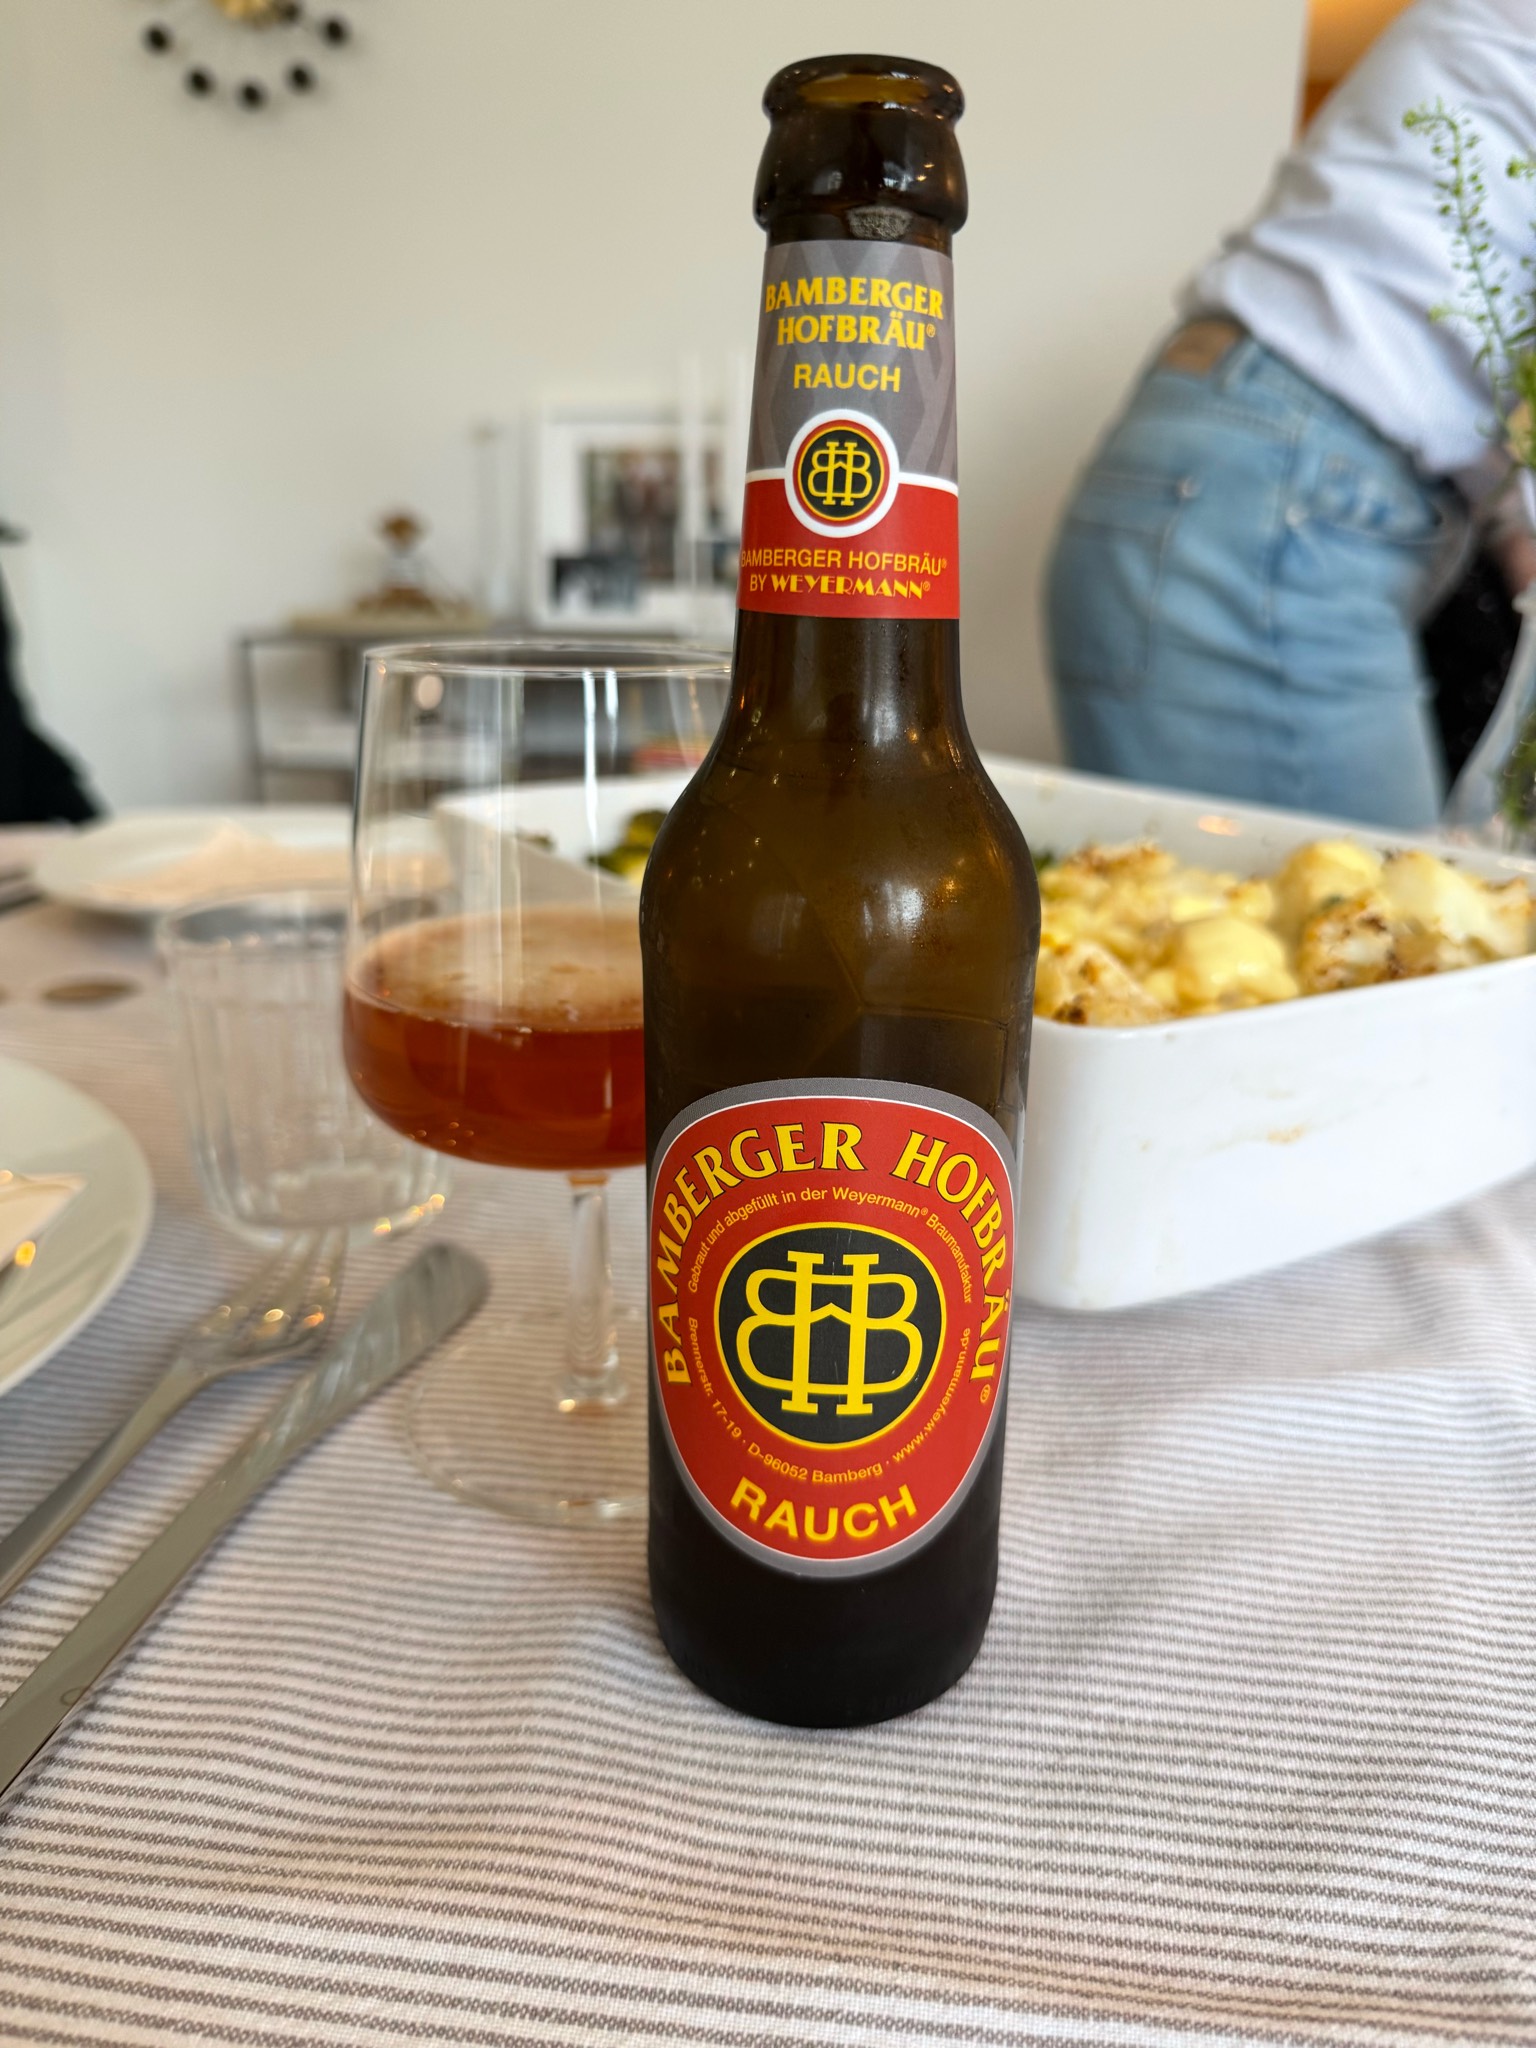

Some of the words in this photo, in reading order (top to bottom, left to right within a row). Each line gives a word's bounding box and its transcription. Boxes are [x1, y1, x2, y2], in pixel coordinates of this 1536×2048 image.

[765, 276, 944, 320] BAMBERGER
[793, 363, 901, 392] RAUCH
[741, 548, 842, 568] BAMBERGER
[750, 574, 767, 592] BY
[657, 1121, 866, 1387] BAMBERGER
[687, 1241, 711, 1293] Gebraut
[707, 1219, 726, 1245] und
[724, 1192, 780, 1228] abgefüllt
[781, 1190, 797, 1204] in
[800, 1186, 828, 1201] der
[925, 1213, 972, 1304] Braumanufaktur
[688, 1317, 714, 1397] Brennerstr.
[712, 1399, 743, 1438] 17-19
[747, 1442, 809, 1480] D-96052
[812, 1462, 884, 1484] Bamberg
[892, 1327, 972, 1463] www.weyermann.de
[730, 1476, 918, 1542] RAUCH
